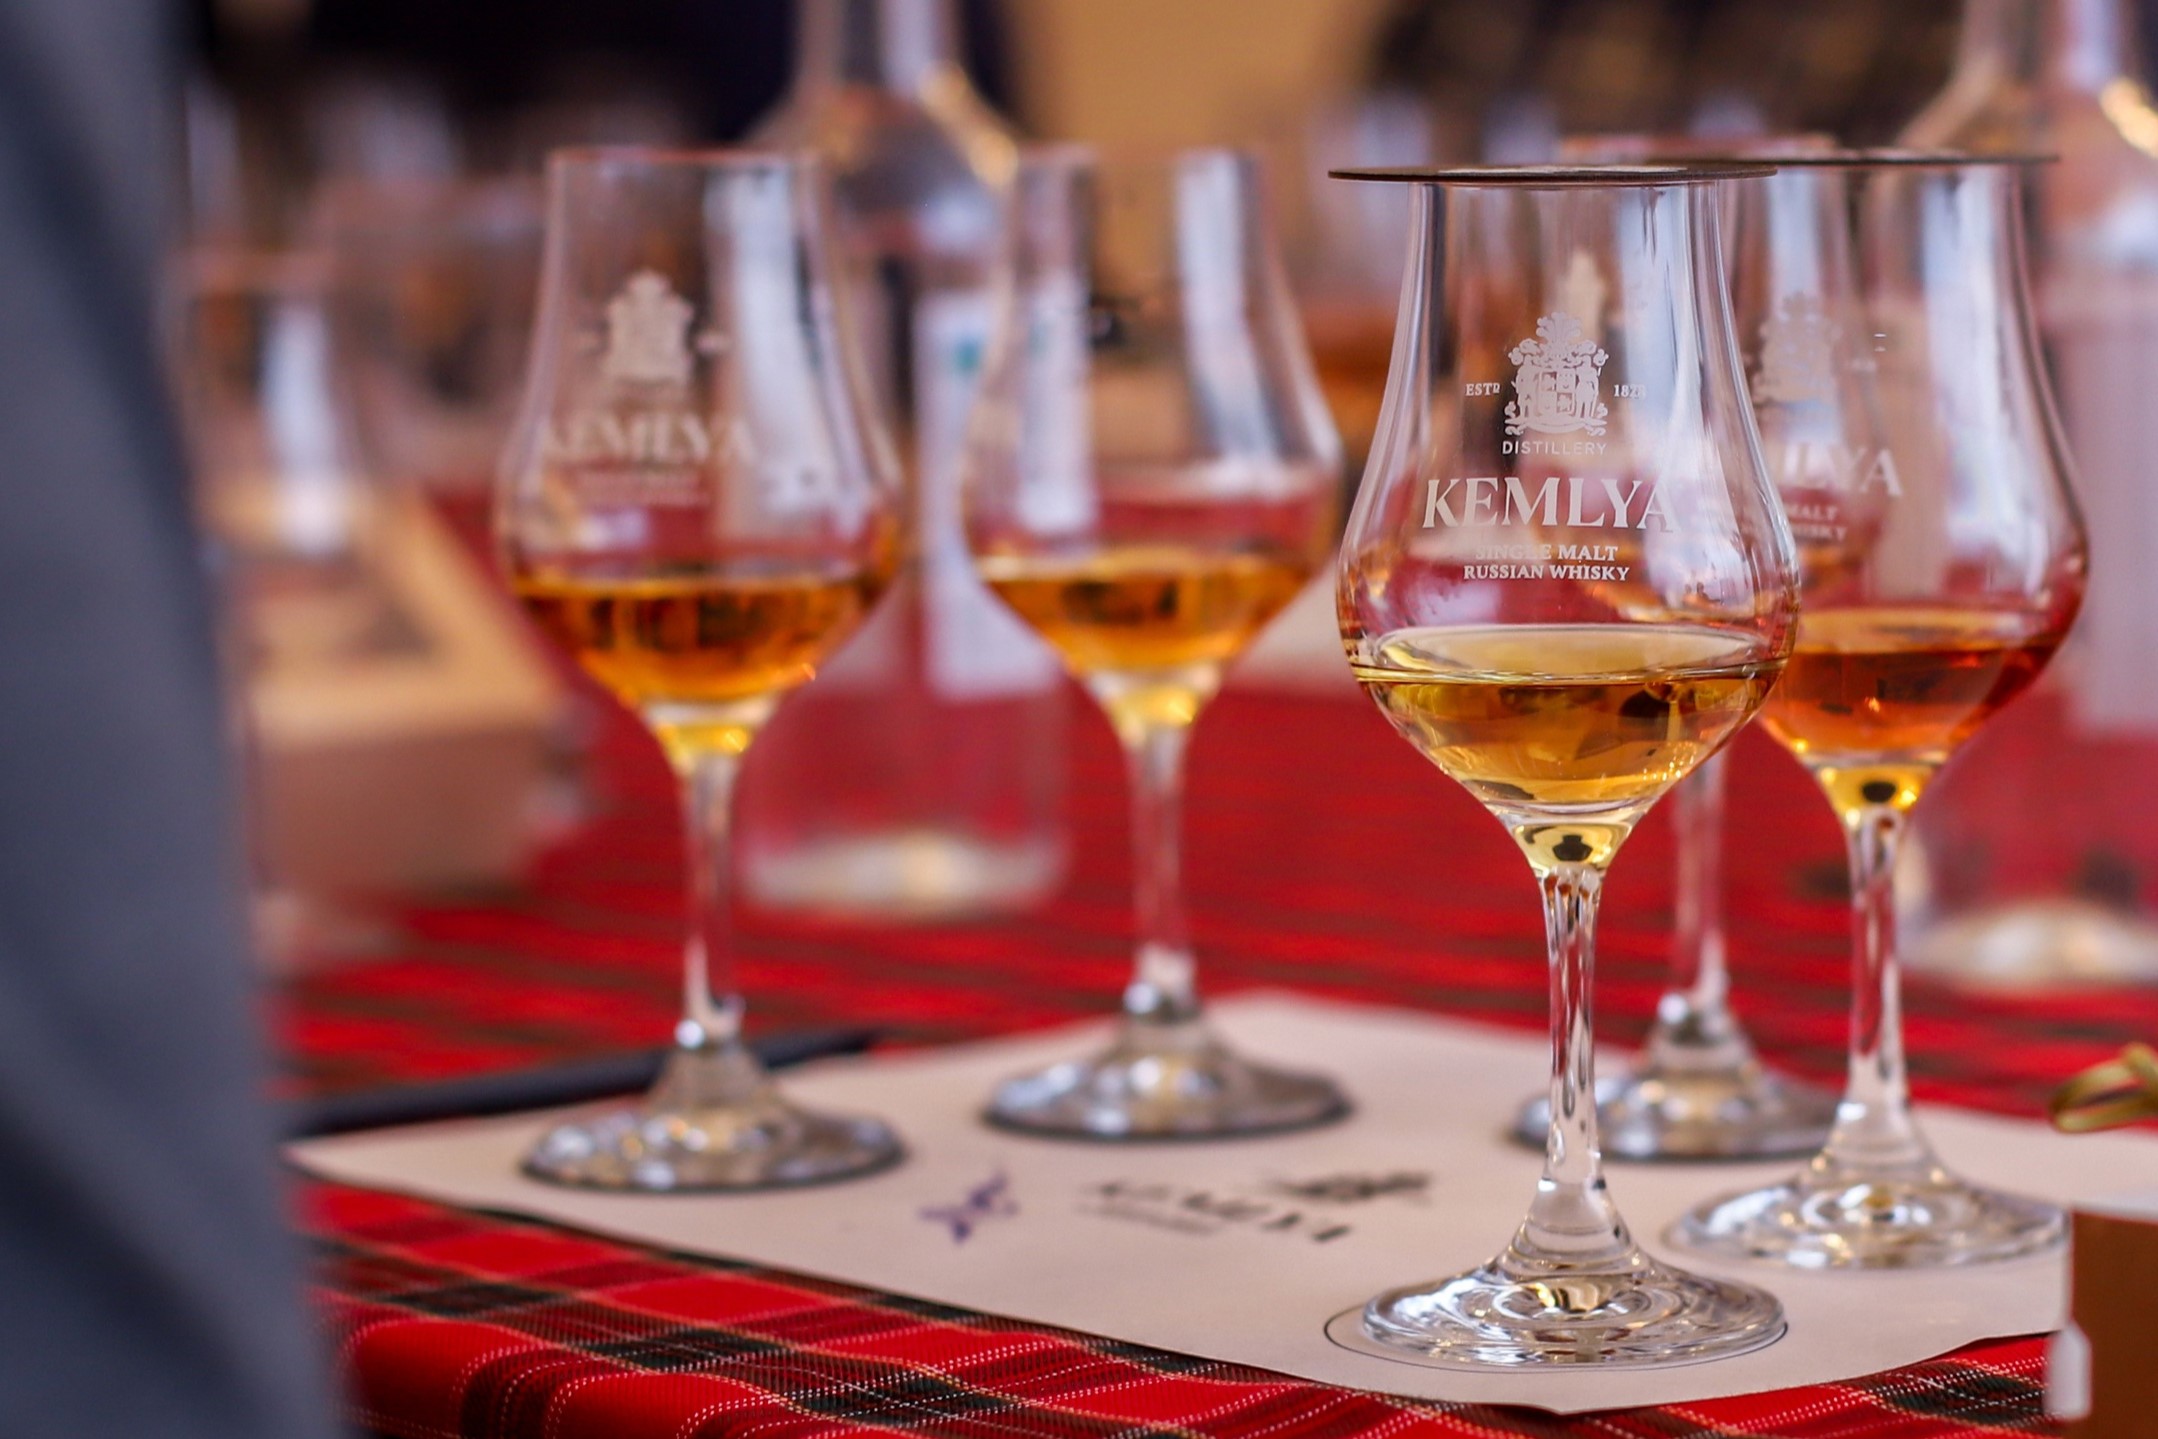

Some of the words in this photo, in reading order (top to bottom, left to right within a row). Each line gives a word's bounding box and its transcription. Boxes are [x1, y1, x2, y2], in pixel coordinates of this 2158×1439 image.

[1502, 440, 1608, 456] DISTILLERY
[1422, 476, 1682, 533] KEMLYA
[1475, 544, 1552, 561] SINGLE
[1557, 544, 1619, 562] MALT
[1463, 564, 1544, 580] RUSSIAN
[1549, 564, 1630, 582] WHISKY
